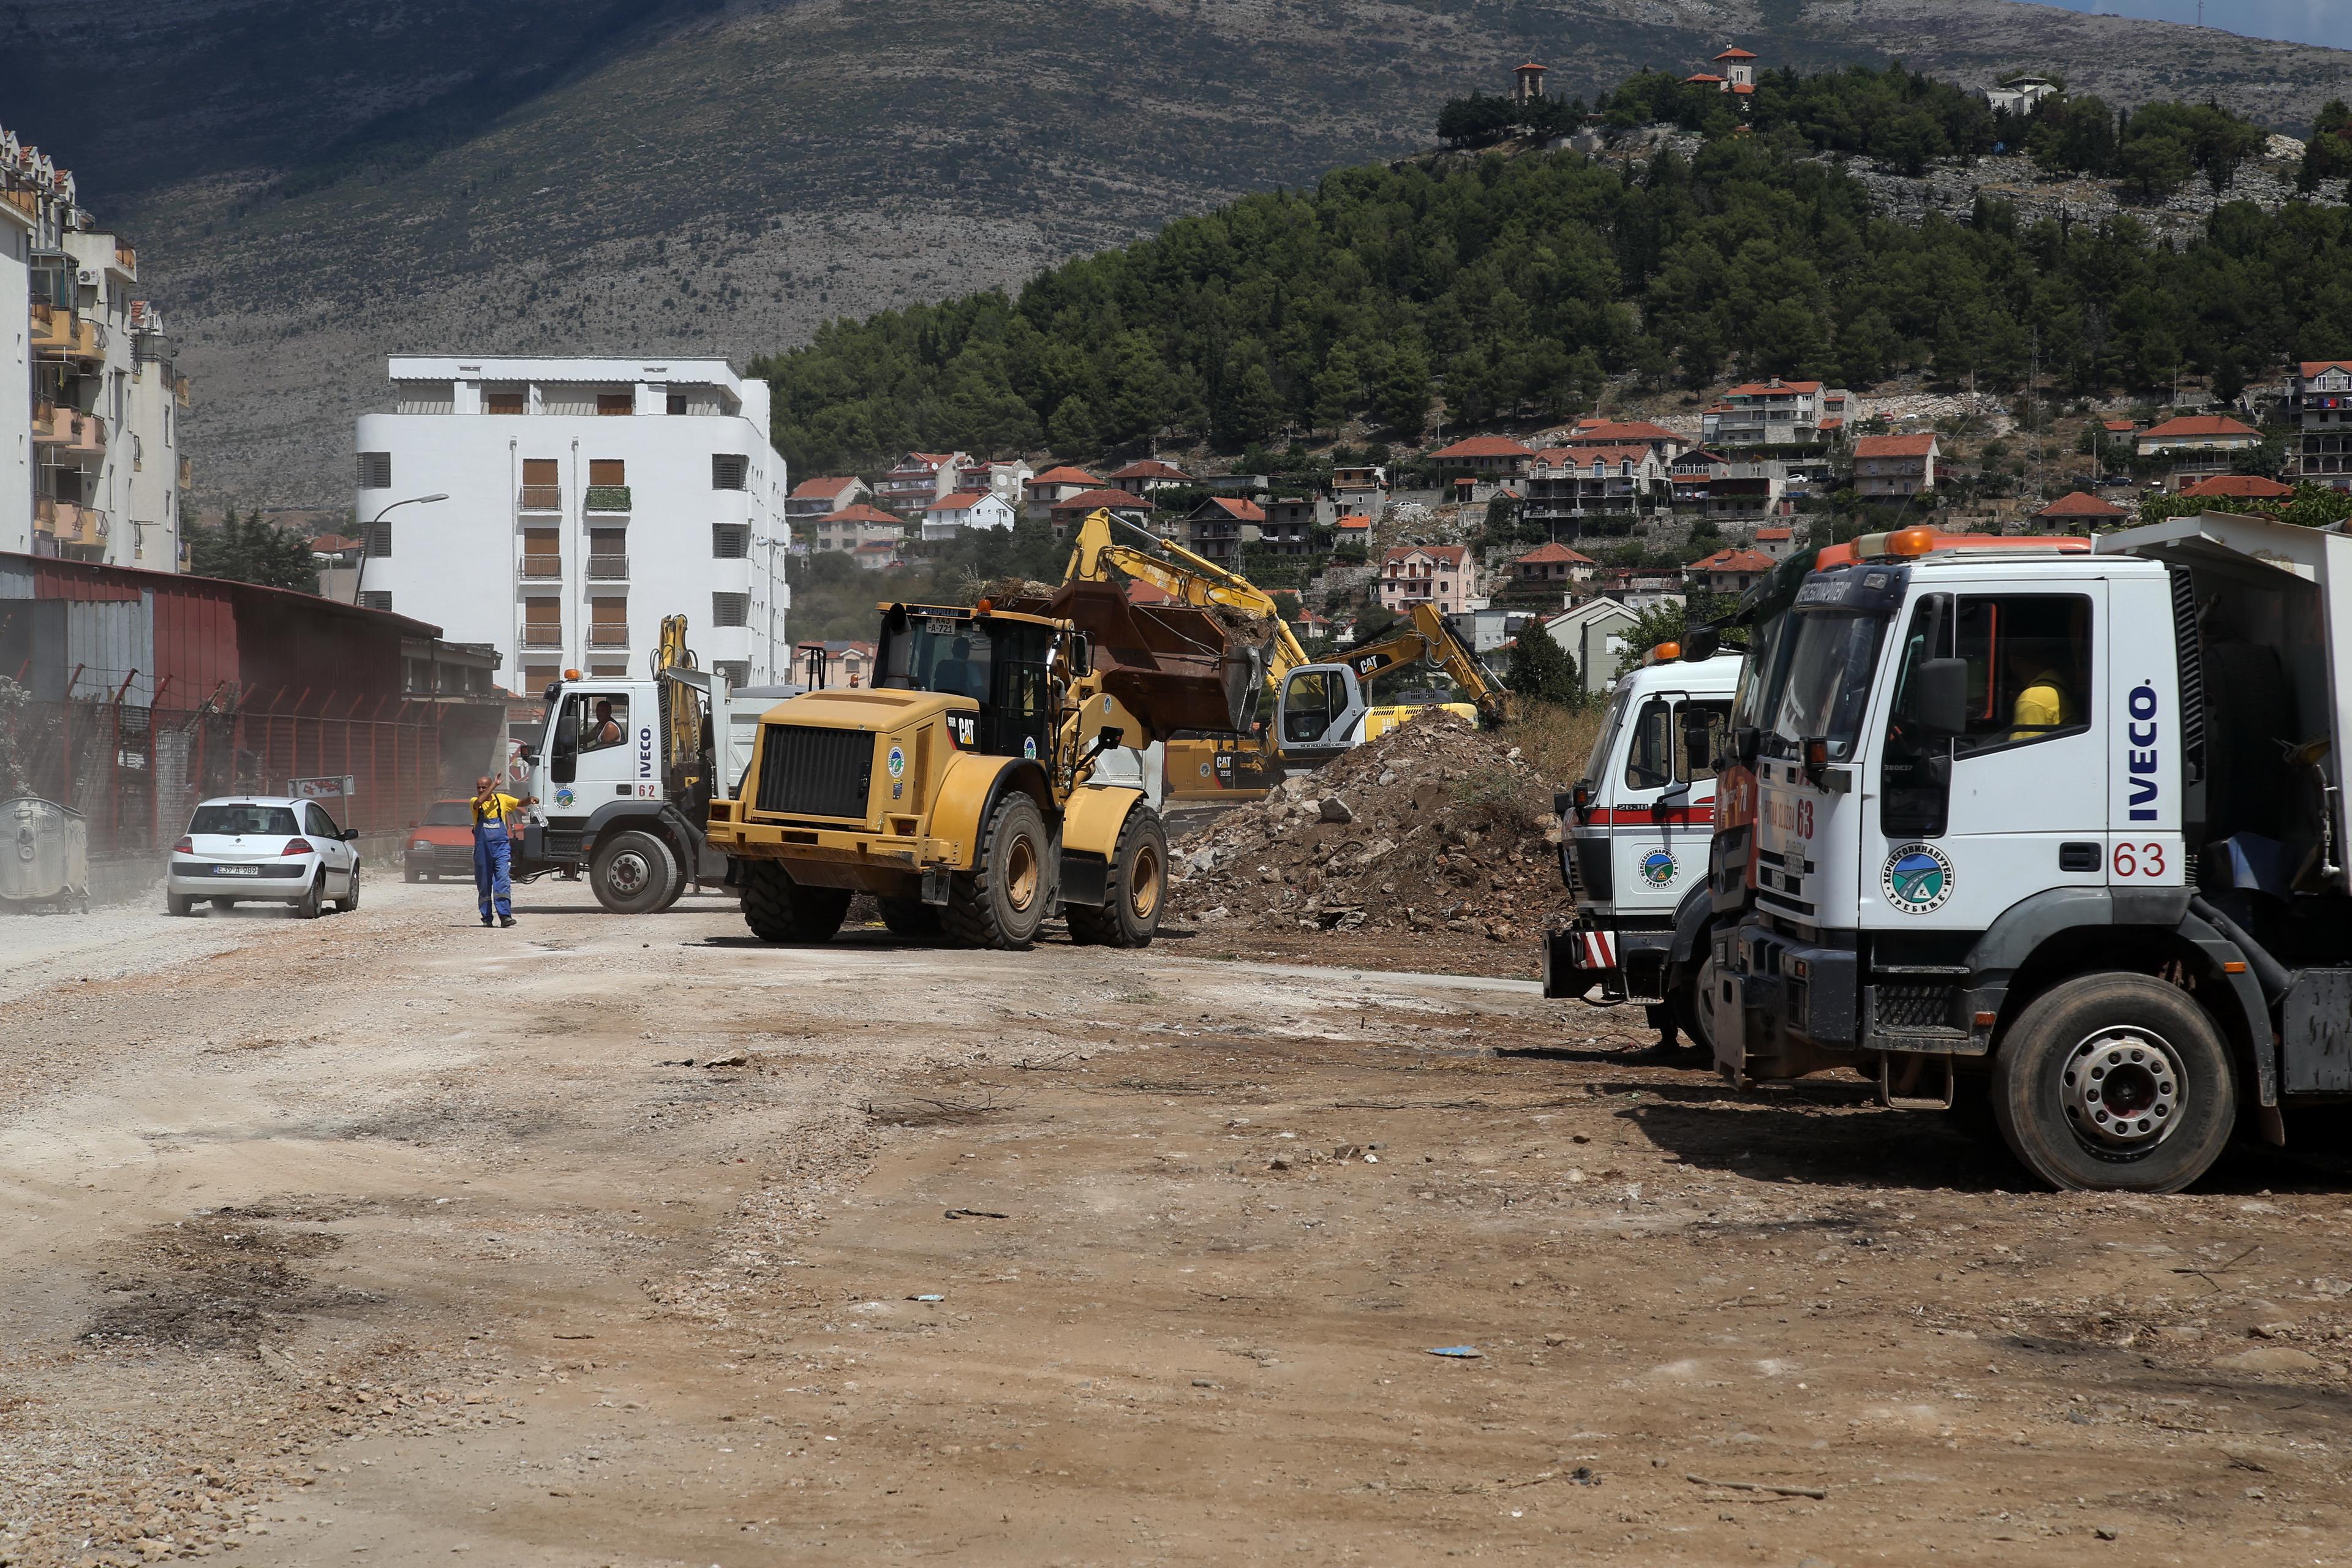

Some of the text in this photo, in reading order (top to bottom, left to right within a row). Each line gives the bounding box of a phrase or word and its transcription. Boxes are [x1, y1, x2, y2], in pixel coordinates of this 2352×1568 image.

[919, 607, 959, 617] CATERPILLAR
[1360, 655, 1378, 674] CAT
[959, 717, 974, 745] CAT
[640, 728, 651, 778] IVECO
[1216, 756, 1232, 769] CAT
[2129, 685, 2158, 821] IVECO
[639, 785, 655, 797] 62
[1797, 798, 1814, 840] 63
[1640, 849, 1678, 877] HERCEGOVINAPUTEVI
[1883, 845, 1952, 886] ХЕРЦЕГОВИНАПУТЕВИ
[2114, 842, 2166, 877] 63
[1645, 878, 1673, 888] TREBINJE
[1889, 893, 1945, 912] ТРЕБИЊЕ
